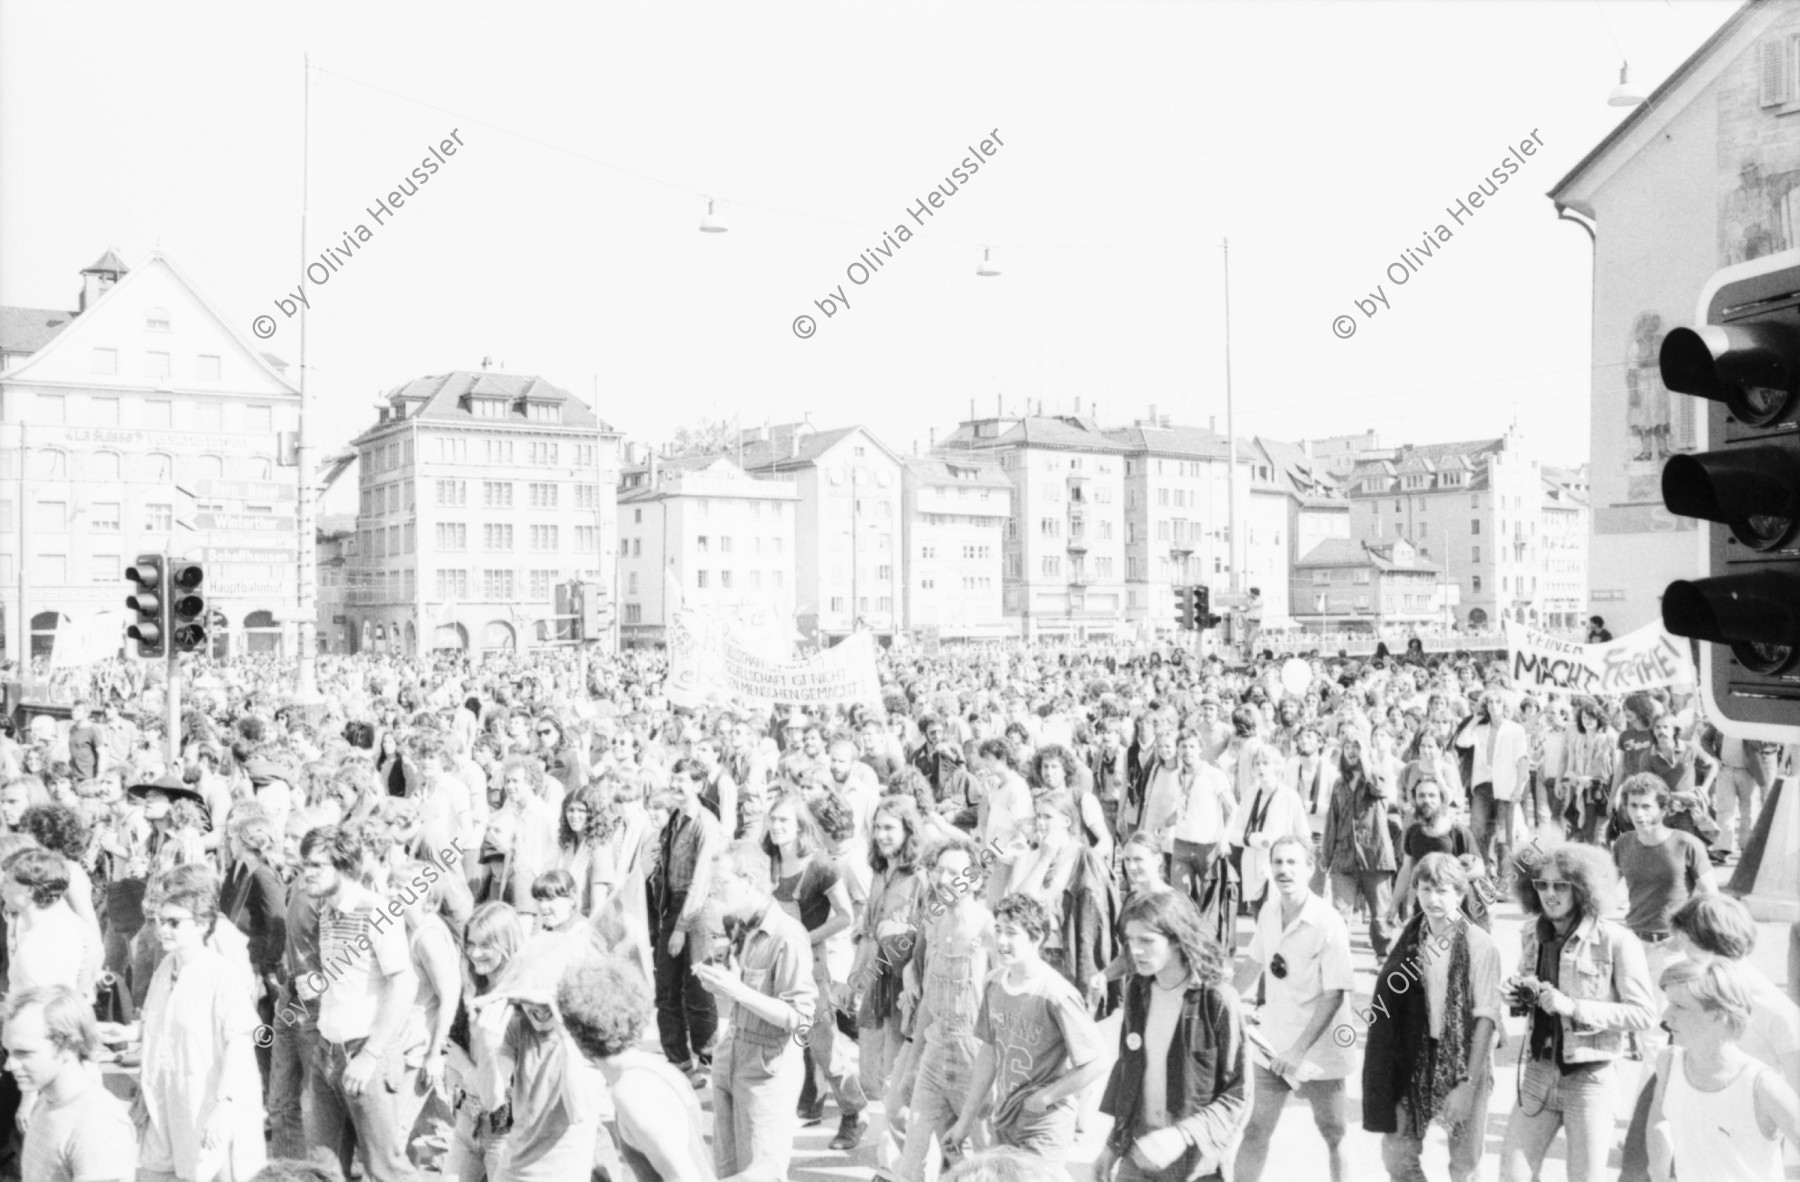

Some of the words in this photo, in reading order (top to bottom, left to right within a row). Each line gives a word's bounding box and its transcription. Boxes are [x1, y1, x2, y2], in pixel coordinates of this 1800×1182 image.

[211, 481, 239, 496] Bern
[247, 483, 280, 498] Basel
[214, 513, 279, 530] Winterthur
[207, 549, 290, 563] Schaffhausen
[209, 579, 283, 596] Hauptbahnhof
[1514, 650, 1600, 694] MACHT
